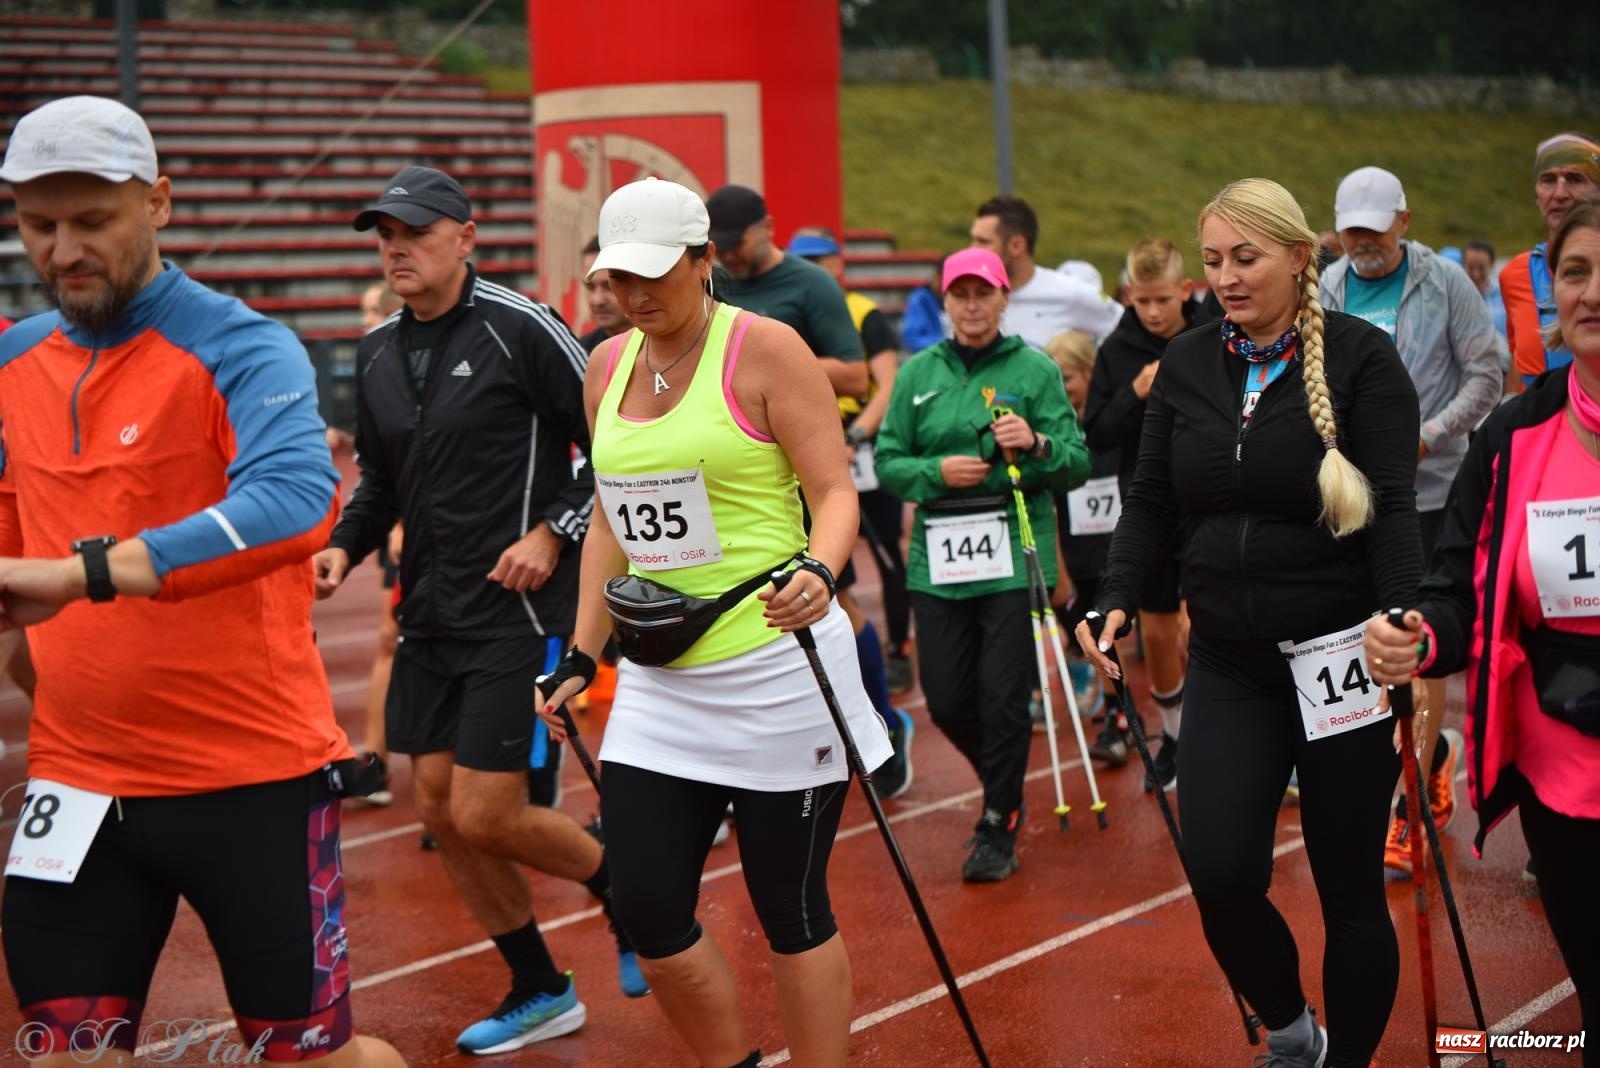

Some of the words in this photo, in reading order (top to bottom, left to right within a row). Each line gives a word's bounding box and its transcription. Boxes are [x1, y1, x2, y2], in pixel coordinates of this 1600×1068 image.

[654, 372, 671, 396] A
[1087, 495, 1113, 517] 97
[617, 501, 688, 541] 135
[942, 533, 994, 562] 144
[1563, 533, 1600, 581] 1
[1316, 657, 1382, 706] 14
[1330, 707, 1375, 727] Racibór
